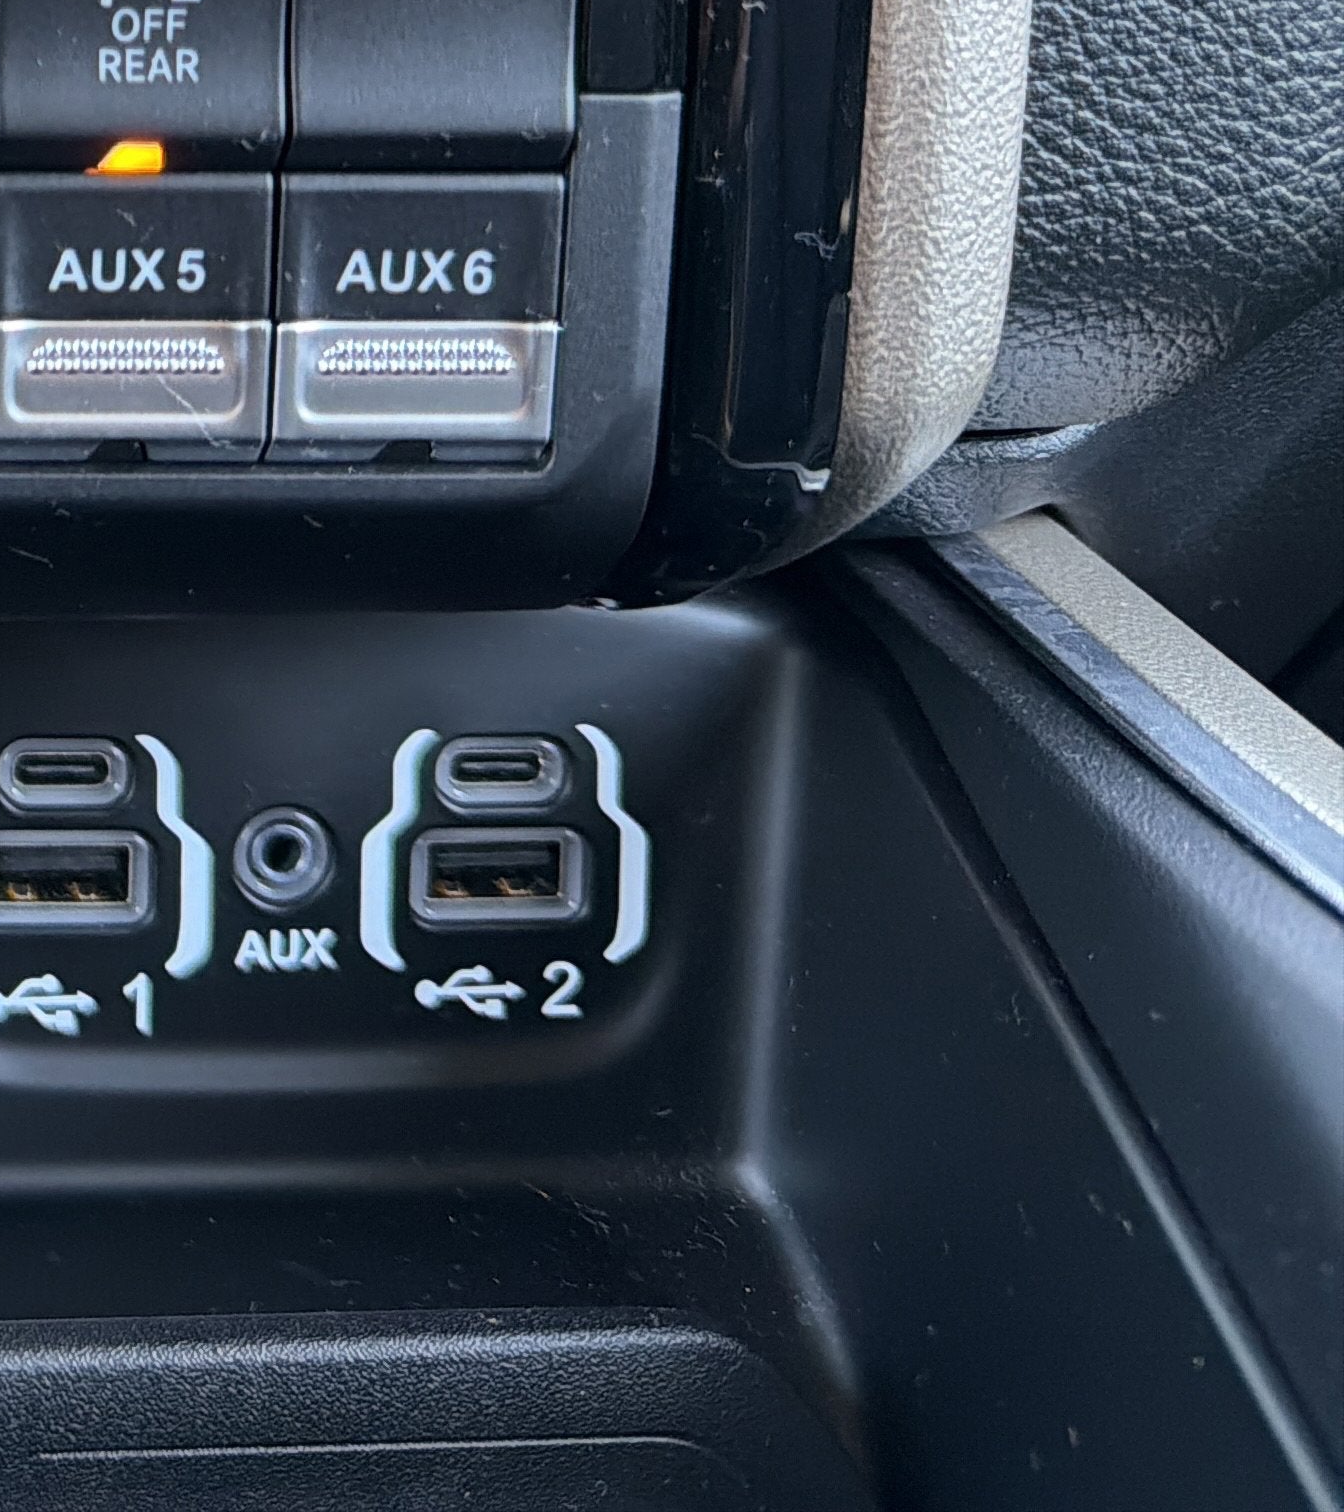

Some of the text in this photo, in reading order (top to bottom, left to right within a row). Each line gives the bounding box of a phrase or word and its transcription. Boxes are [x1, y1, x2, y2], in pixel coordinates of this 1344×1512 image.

[111, 7, 188, 44] OFF
[98, 47, 199, 84] REAR
[48, 248, 206, 293] AUX 5
[335, 248, 495, 295] AUX 6
[234, 927, 337, 971] AUX
[122, 972, 153, 1036] 1
[540, 960, 582, 1017] 2
